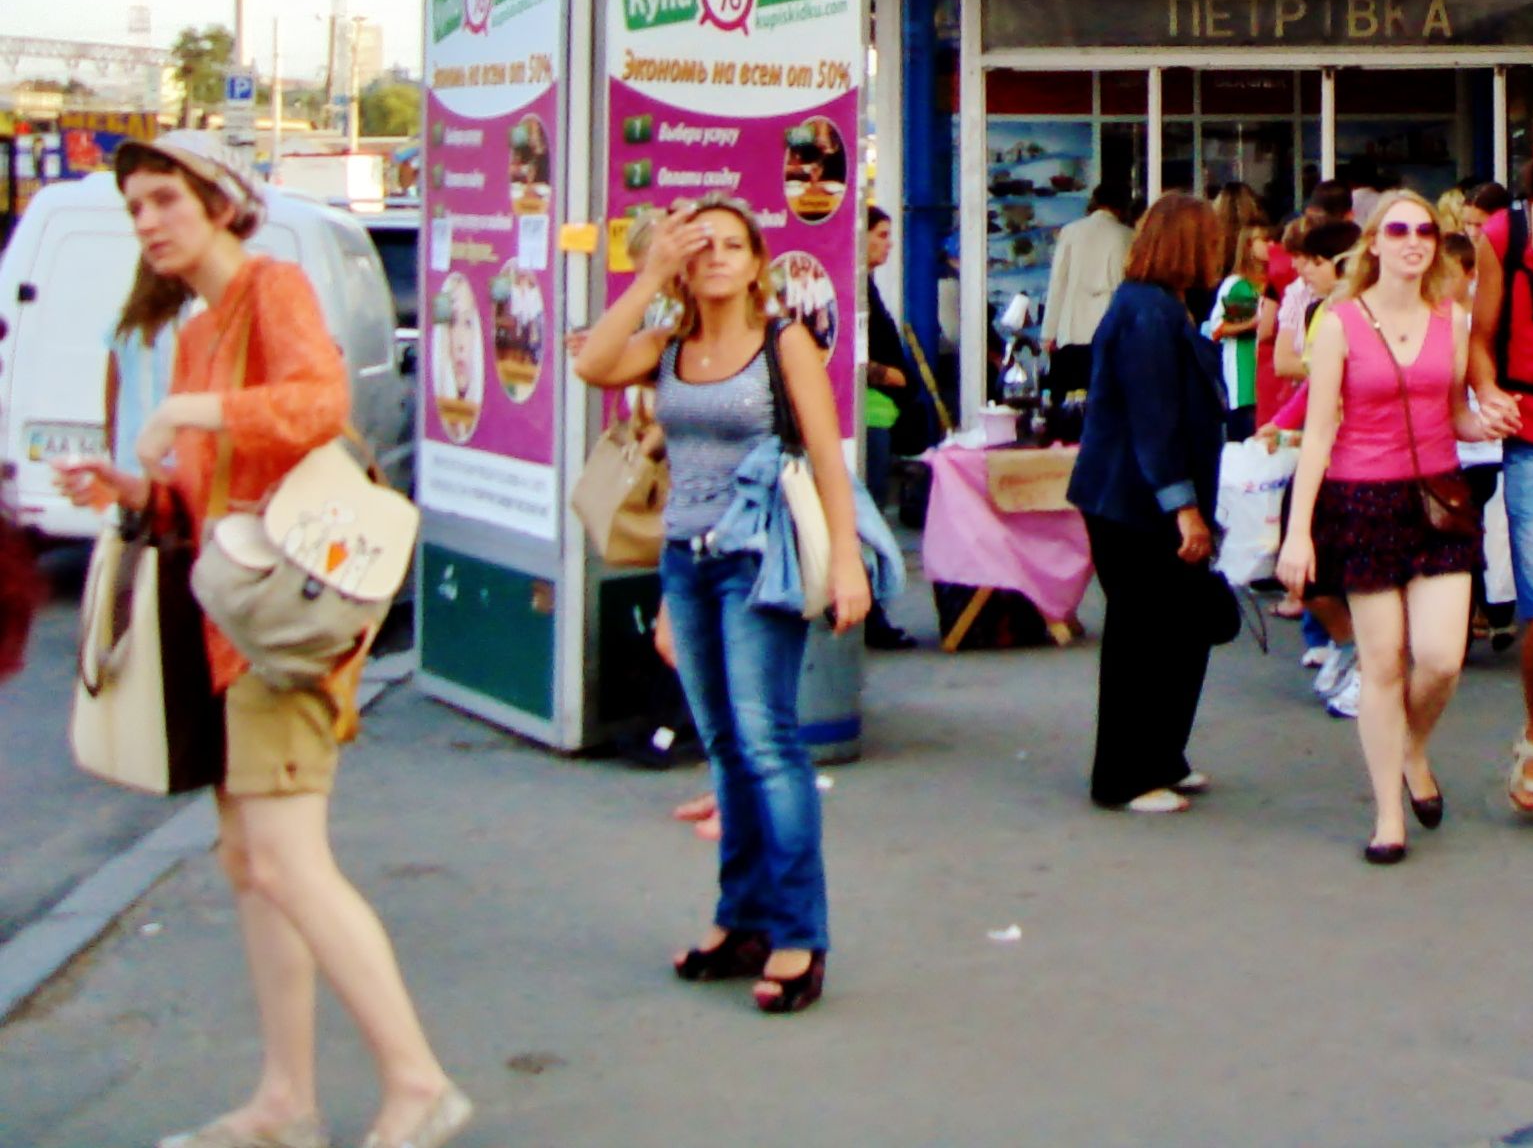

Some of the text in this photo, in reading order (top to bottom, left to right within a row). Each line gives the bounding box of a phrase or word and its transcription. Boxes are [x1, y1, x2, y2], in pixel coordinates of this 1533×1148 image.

[711, 61, 735, 86] на
[738, 61, 783, 88] всем
[815, 58, 852, 90] 50%
